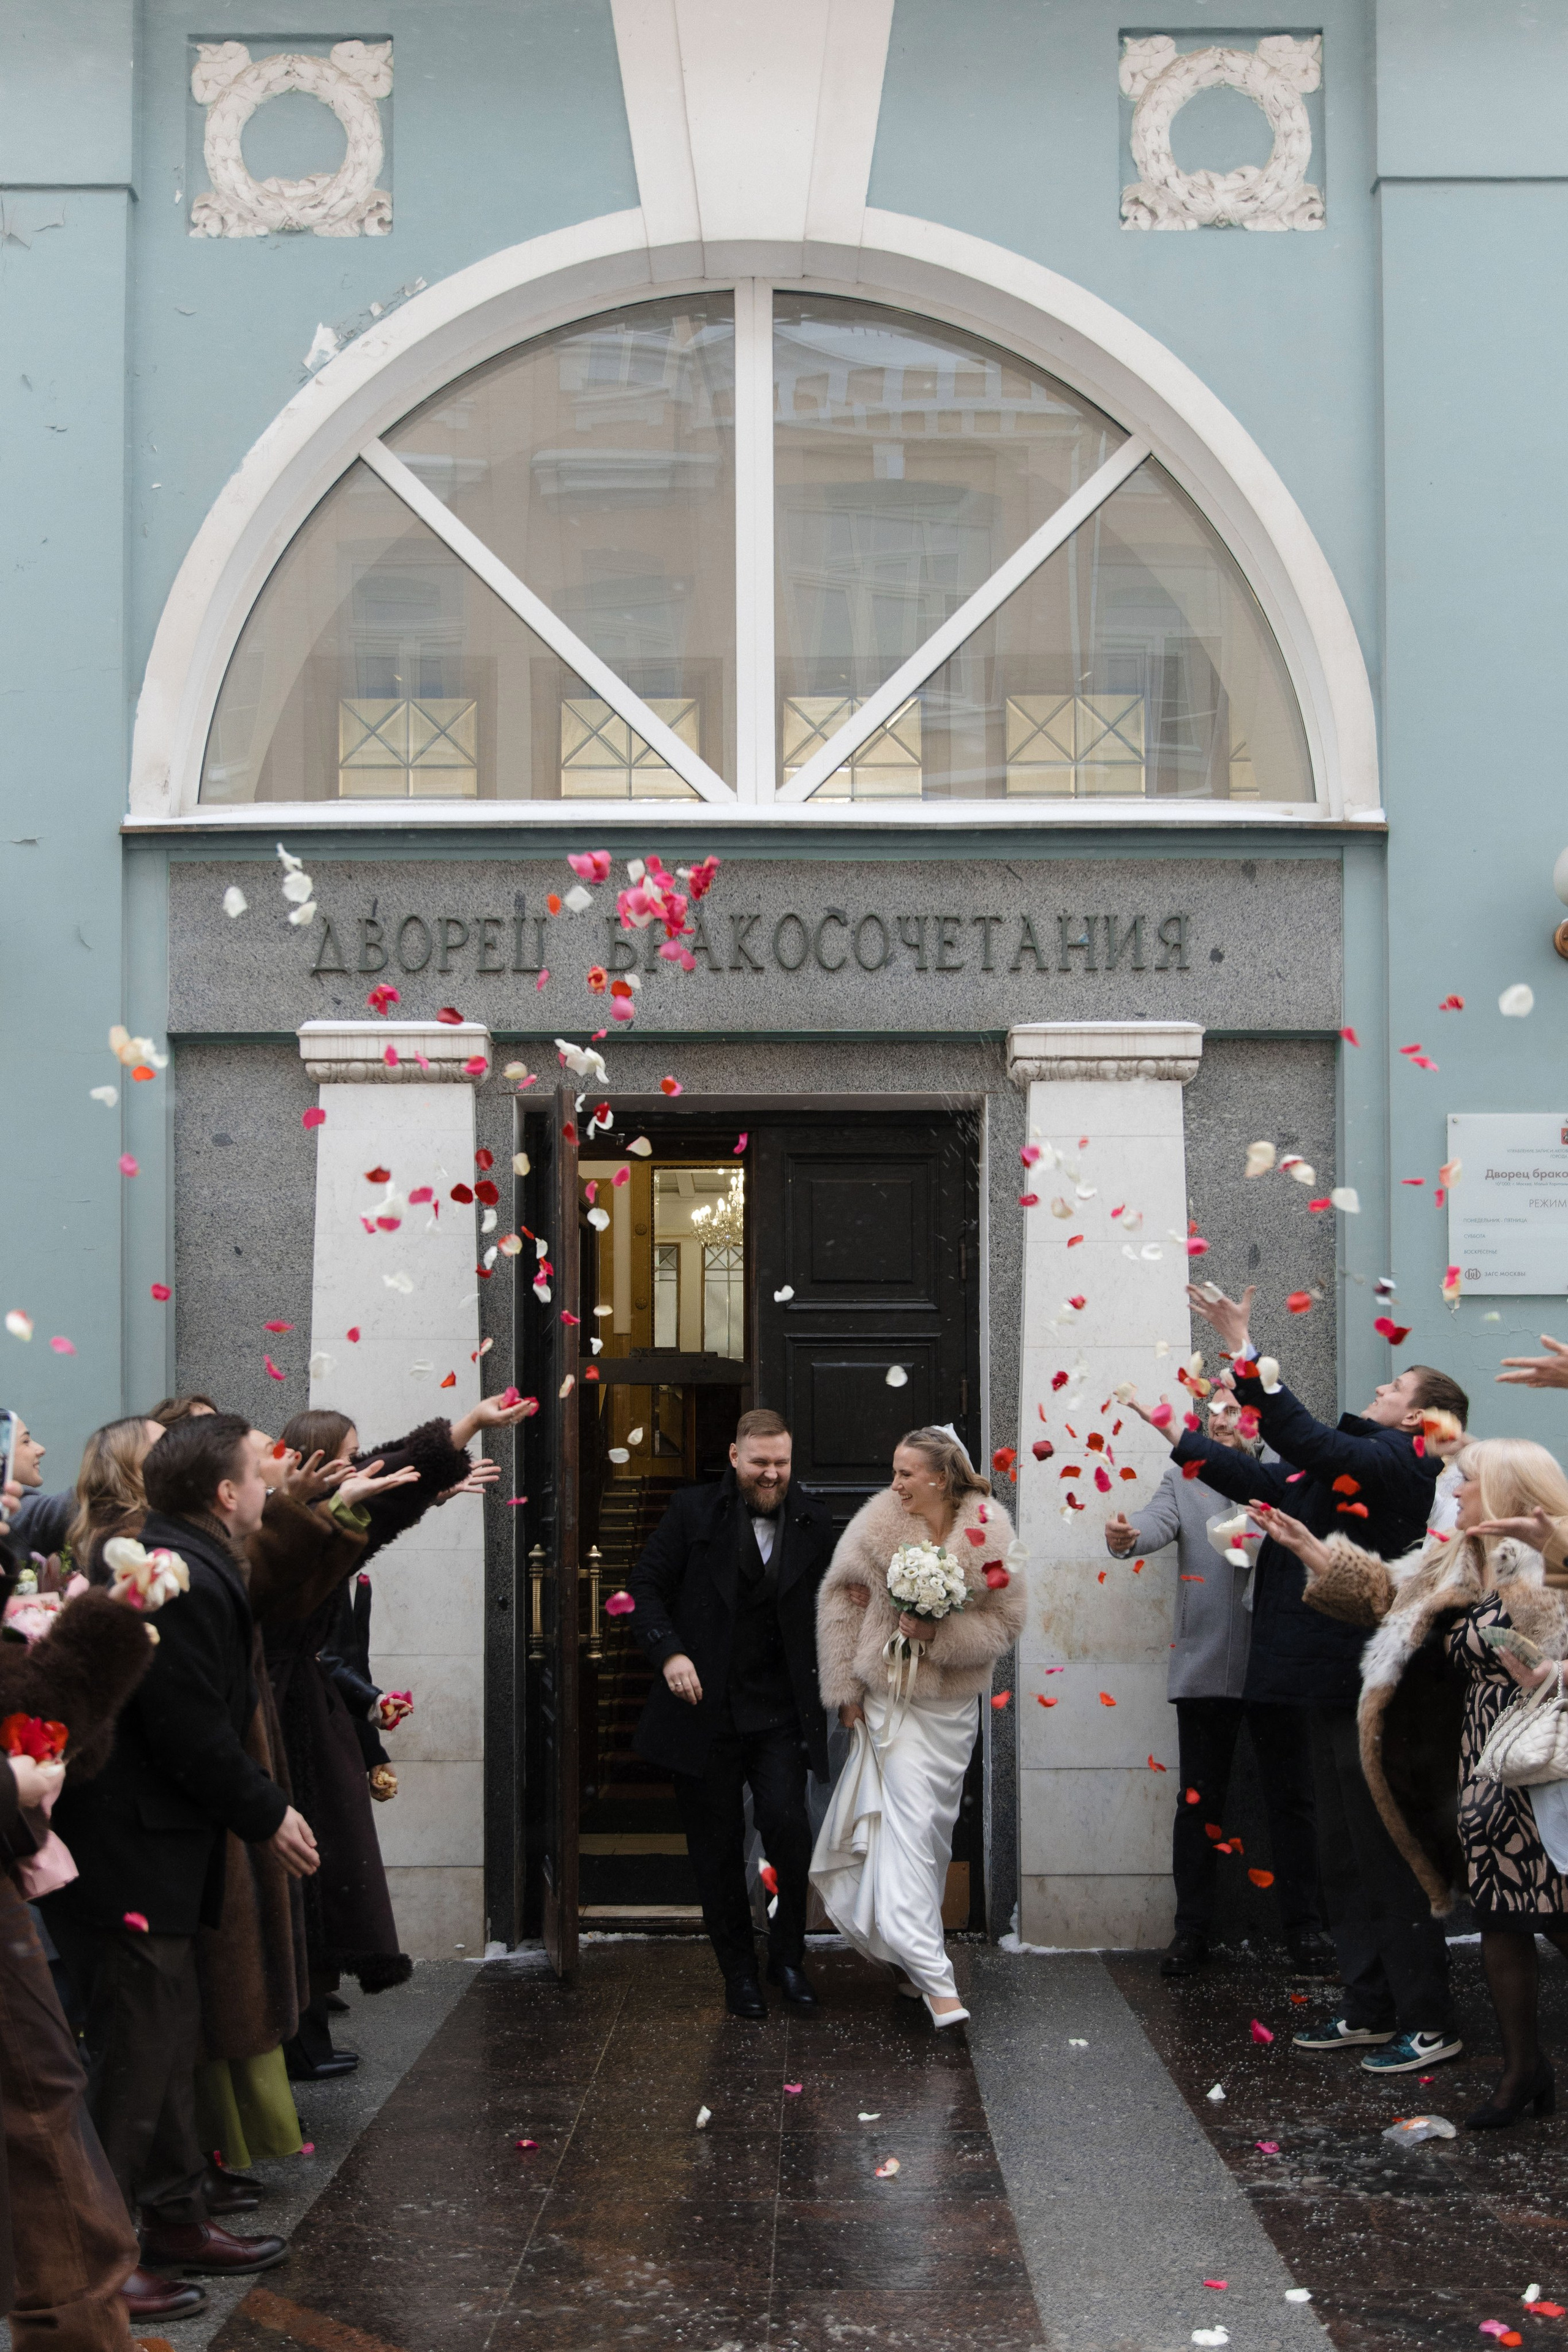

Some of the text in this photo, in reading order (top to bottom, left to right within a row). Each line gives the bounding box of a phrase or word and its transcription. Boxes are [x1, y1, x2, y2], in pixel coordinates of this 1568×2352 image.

[309, 913, 547, 974] ДВОРЕЦ
[1485, 1169, 1529, 1181] Дворец
[1529, 1199, 1567, 1208] РЕЖИМ
